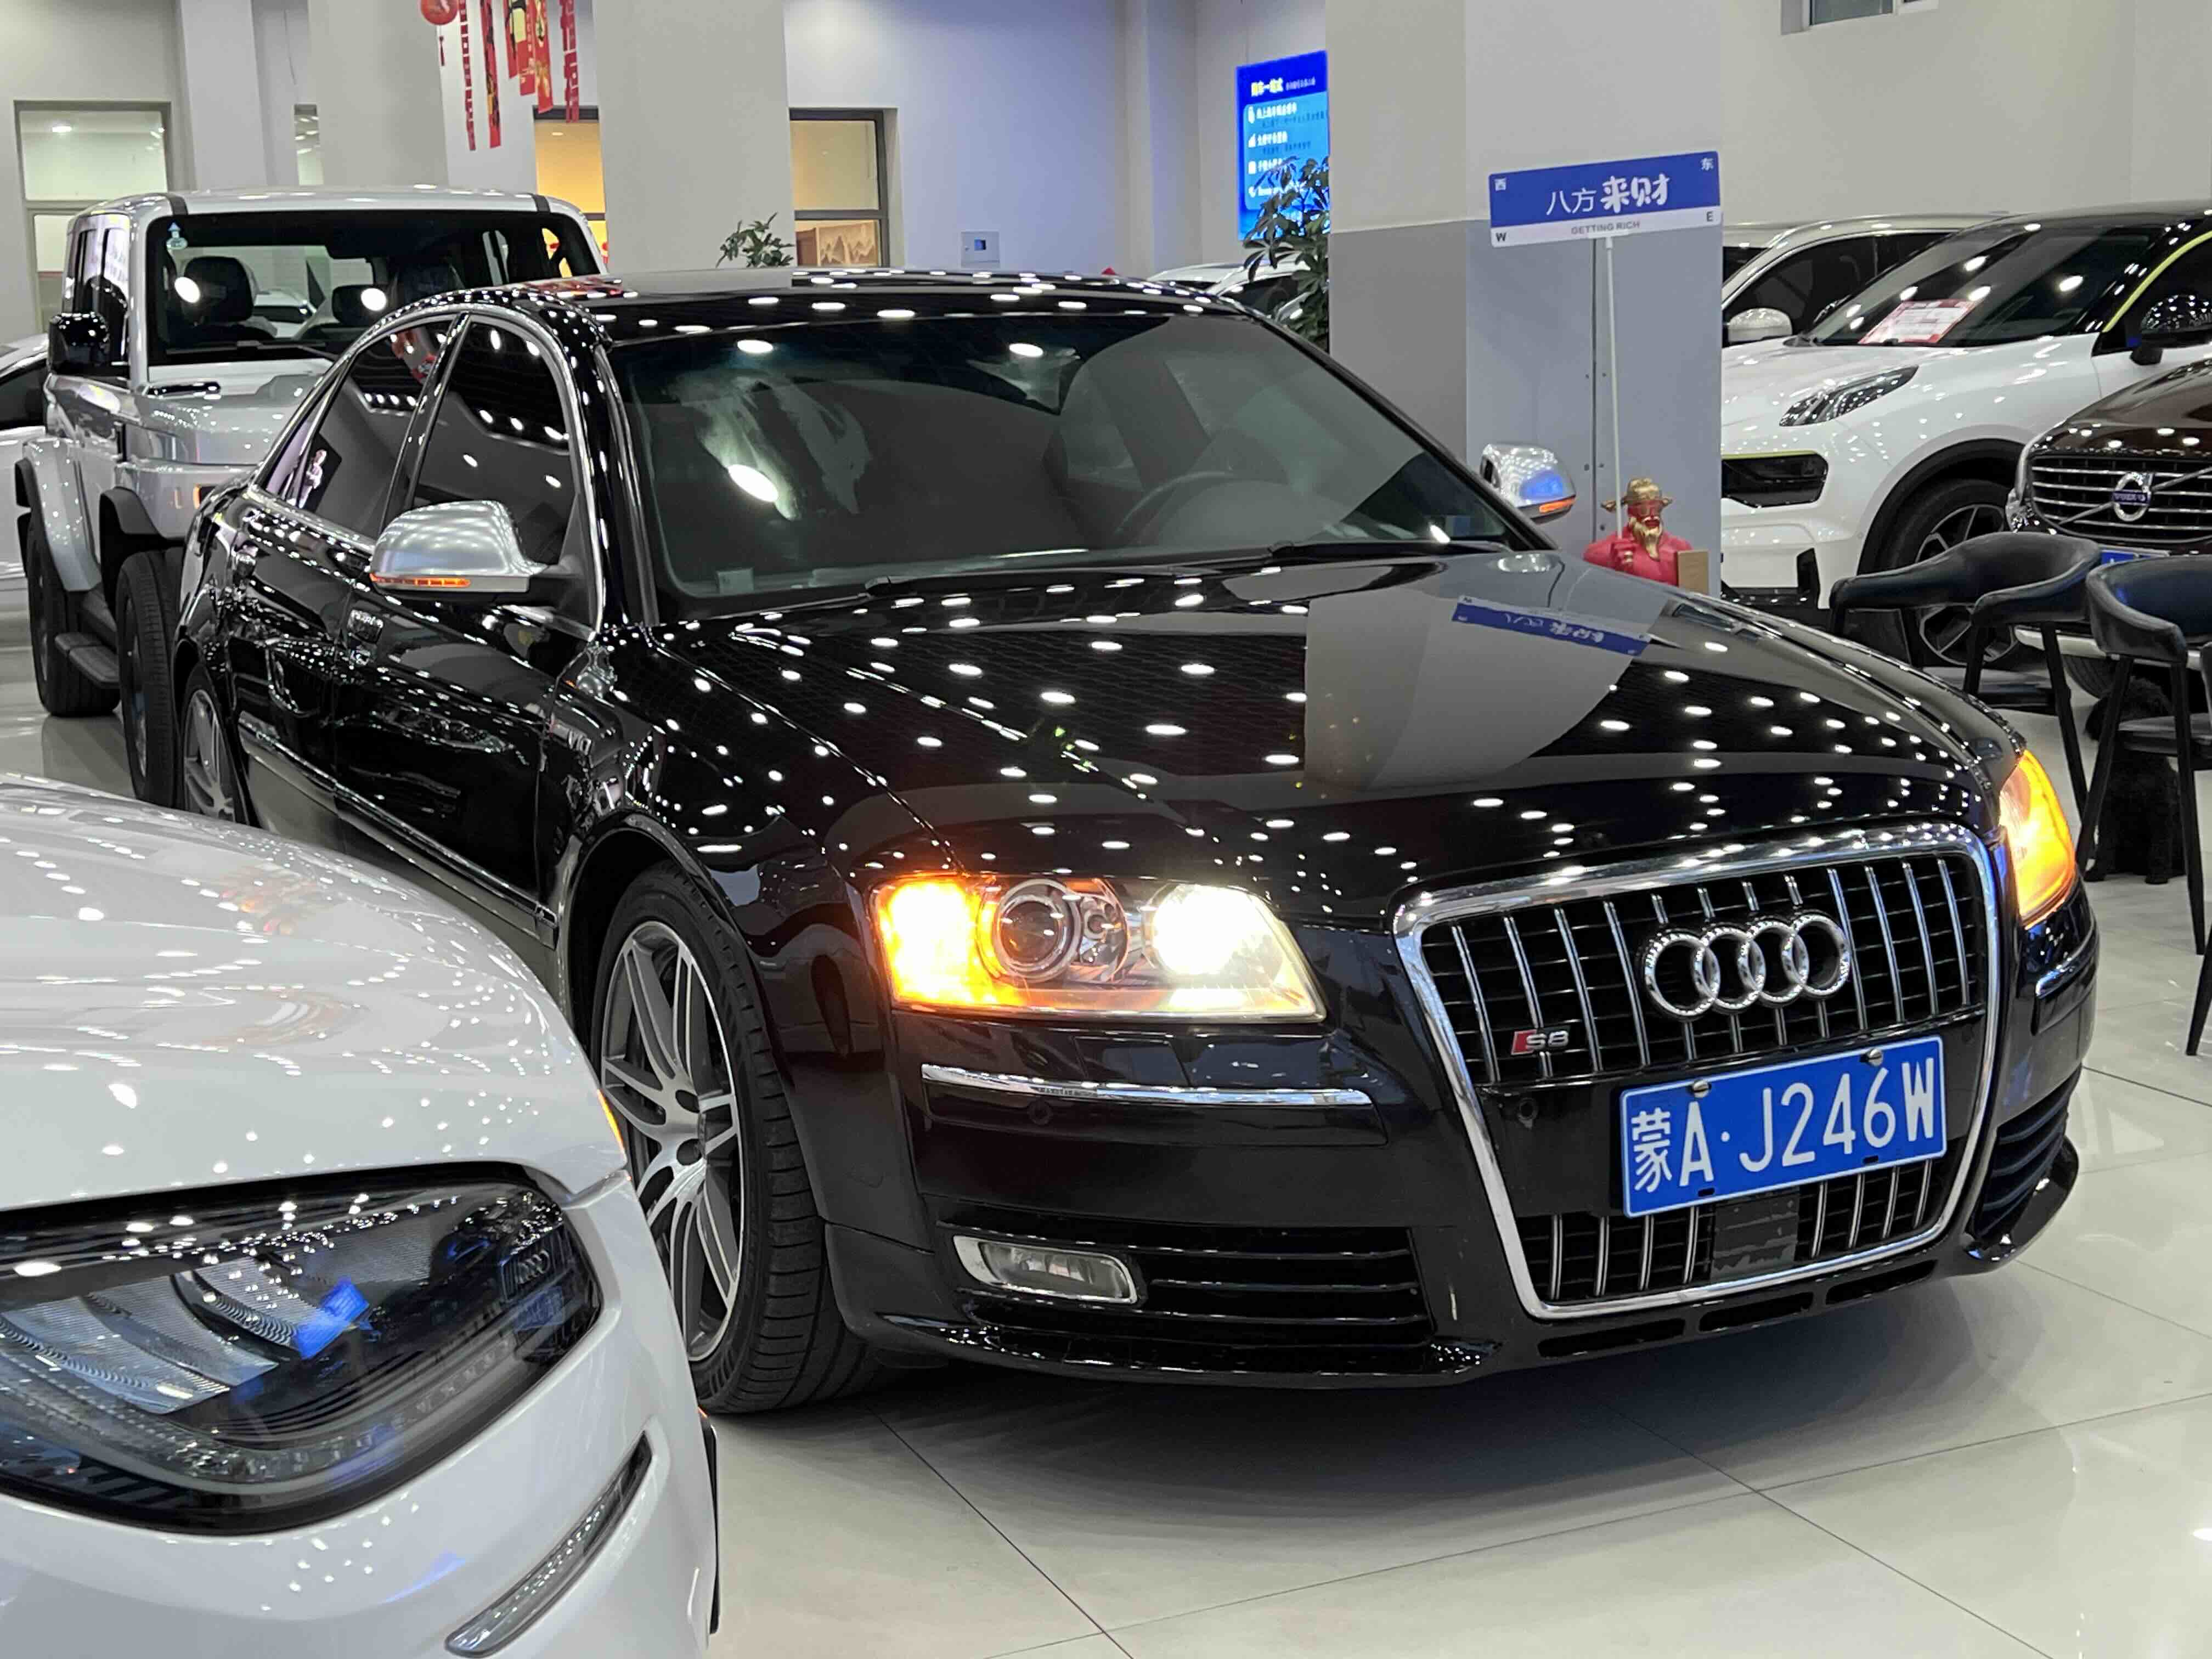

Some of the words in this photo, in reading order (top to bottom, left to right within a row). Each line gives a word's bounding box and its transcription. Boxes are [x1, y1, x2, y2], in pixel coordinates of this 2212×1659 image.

[1701, 157, 1714, 171] 东
[1494, 178, 1506, 191] 西
[1546, 173, 1671, 216] 八方来财
[1706, 212, 1713, 222] E
[1571, 223, 1614, 235] GETTING
[1616, 220, 1640, 231] RICH
[1496, 233, 1507, 242] W
[1525, 1030, 1569, 1050] S8
[1630, 1057, 1934, 1193] 蒙A·J246W
